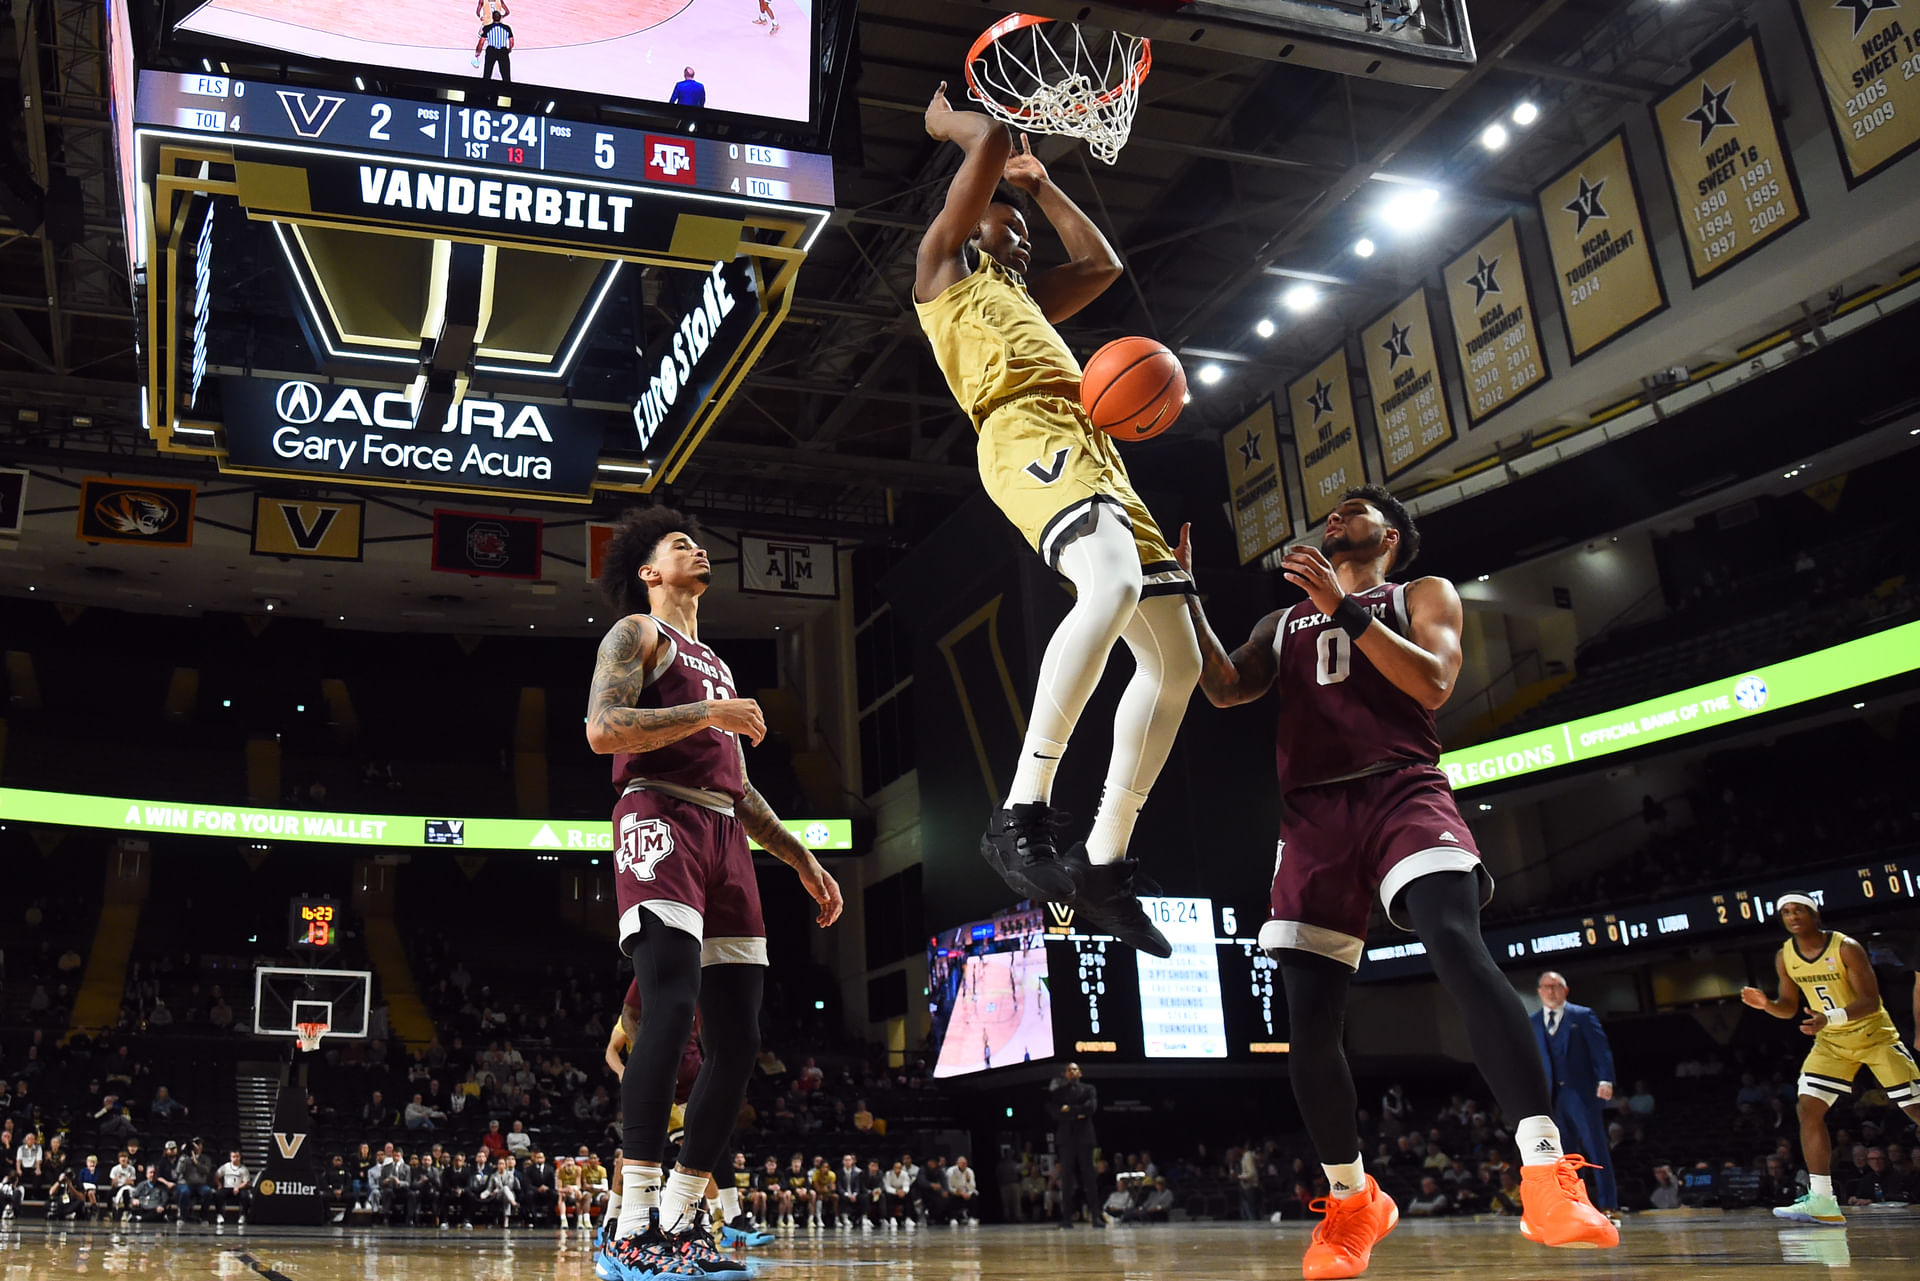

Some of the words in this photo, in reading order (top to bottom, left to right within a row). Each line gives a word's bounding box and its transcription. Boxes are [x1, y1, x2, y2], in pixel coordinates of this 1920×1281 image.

[1862, 21, 1904, 60] NCAA
[1852, 45, 1898, 88] SWEET
[198, 78, 223, 94] FLS
[234, 81, 246, 98] 0
[1845, 78, 1888, 118] 2005
[196, 112, 222, 130] TOL
[230, 115, 241, 131] 4
[369, 103, 392, 141] 2
[417, 108, 440, 122] POSS
[458, 108, 538, 147] 16:24
[1853, 101, 1895, 140] 2009
[549, 125, 572, 139] POSS
[464, 141, 489, 160] 1ST
[507, 147, 524, 164] 13
[594, 132, 616, 170] 5
[729, 143, 740, 161] 0
[749, 146, 773, 164] FLS
[1706, 137, 1741, 172] NCAA
[730, 177, 741, 194] 4
[750, 180, 774, 197] TOL
[1698, 159, 1737, 196] SWEET
[1740, 146, 1759, 168] 16
[358, 165, 633, 233] VANDERBILT
[1693, 189, 1728, 222] 1990
[1739, 158, 1773, 193] 1991
[1698, 210, 1733, 243] 1994
[1745, 179, 1780, 213] 1995
[1582, 229, 1611, 258] NCAA
[1703, 231, 1737, 264] 1997
[1750, 201, 1786, 235] 2004
[1565, 229, 1635, 287] TOURNAMENT
[1570, 276, 1600, 305] 2014
[1465, 305, 1525, 357] TOURNAMENT
[1480, 303, 1505, 330] NCAA
[633, 260, 736, 452] EUROSTONE
[1474, 366, 1499, 393] 2010
[1507, 345, 1531, 372] 2011
[1381, 370, 1433, 416] TOURNAMENT
[1478, 386, 1504, 411] 2012
[1511, 363, 1537, 391] 2013
[272, 426, 357, 470] Gary
[362, 434, 453, 472] Force
[459, 443, 552, 480] Acura
[1022, 446, 1074, 485] V
[1320, 468, 1346, 498] 1984
[278, 503, 342, 551] V
[1288, 613, 1331, 635] TEXA
[679, 651, 719, 680] TEXAS
[1316, 627, 1351, 686] 0
[1445, 743, 1556, 787] REGIONS
[1579, 723, 1640, 747] OFFICIAL
[1640, 710, 1680, 733] BANK
[1680, 704, 1700, 721] OF
[1700, 695, 1731, 715] THE
[125, 805, 141, 825] A
[145, 806, 188, 828] WIN
[193, 810, 237, 832] FOR
[240, 813, 299, 836] YOUR
[303, 817, 388, 840] WALLET
[1862, 880, 1874, 898] 0
[1888, 875, 1900, 894] 0
[302, 906, 333, 921] 16:23
[1152, 901, 1198, 923] 16:24
[1222, 907, 1238, 936] 5
[1716, 906, 1729, 924] 2
[1740, 902, 1752, 920] 0
[308, 921, 329, 946] 13
[1586, 928, 1597, 945] 0
[1607, 924, 1619, 942] 0
[1794, 972, 1841, 984] VANDERBILT
[1089, 994, 1098, 1007] 2
[1814, 986, 1836, 1011] 5
[273, 1132, 307, 1159] V
[275, 1181, 317, 1196] Hiller
